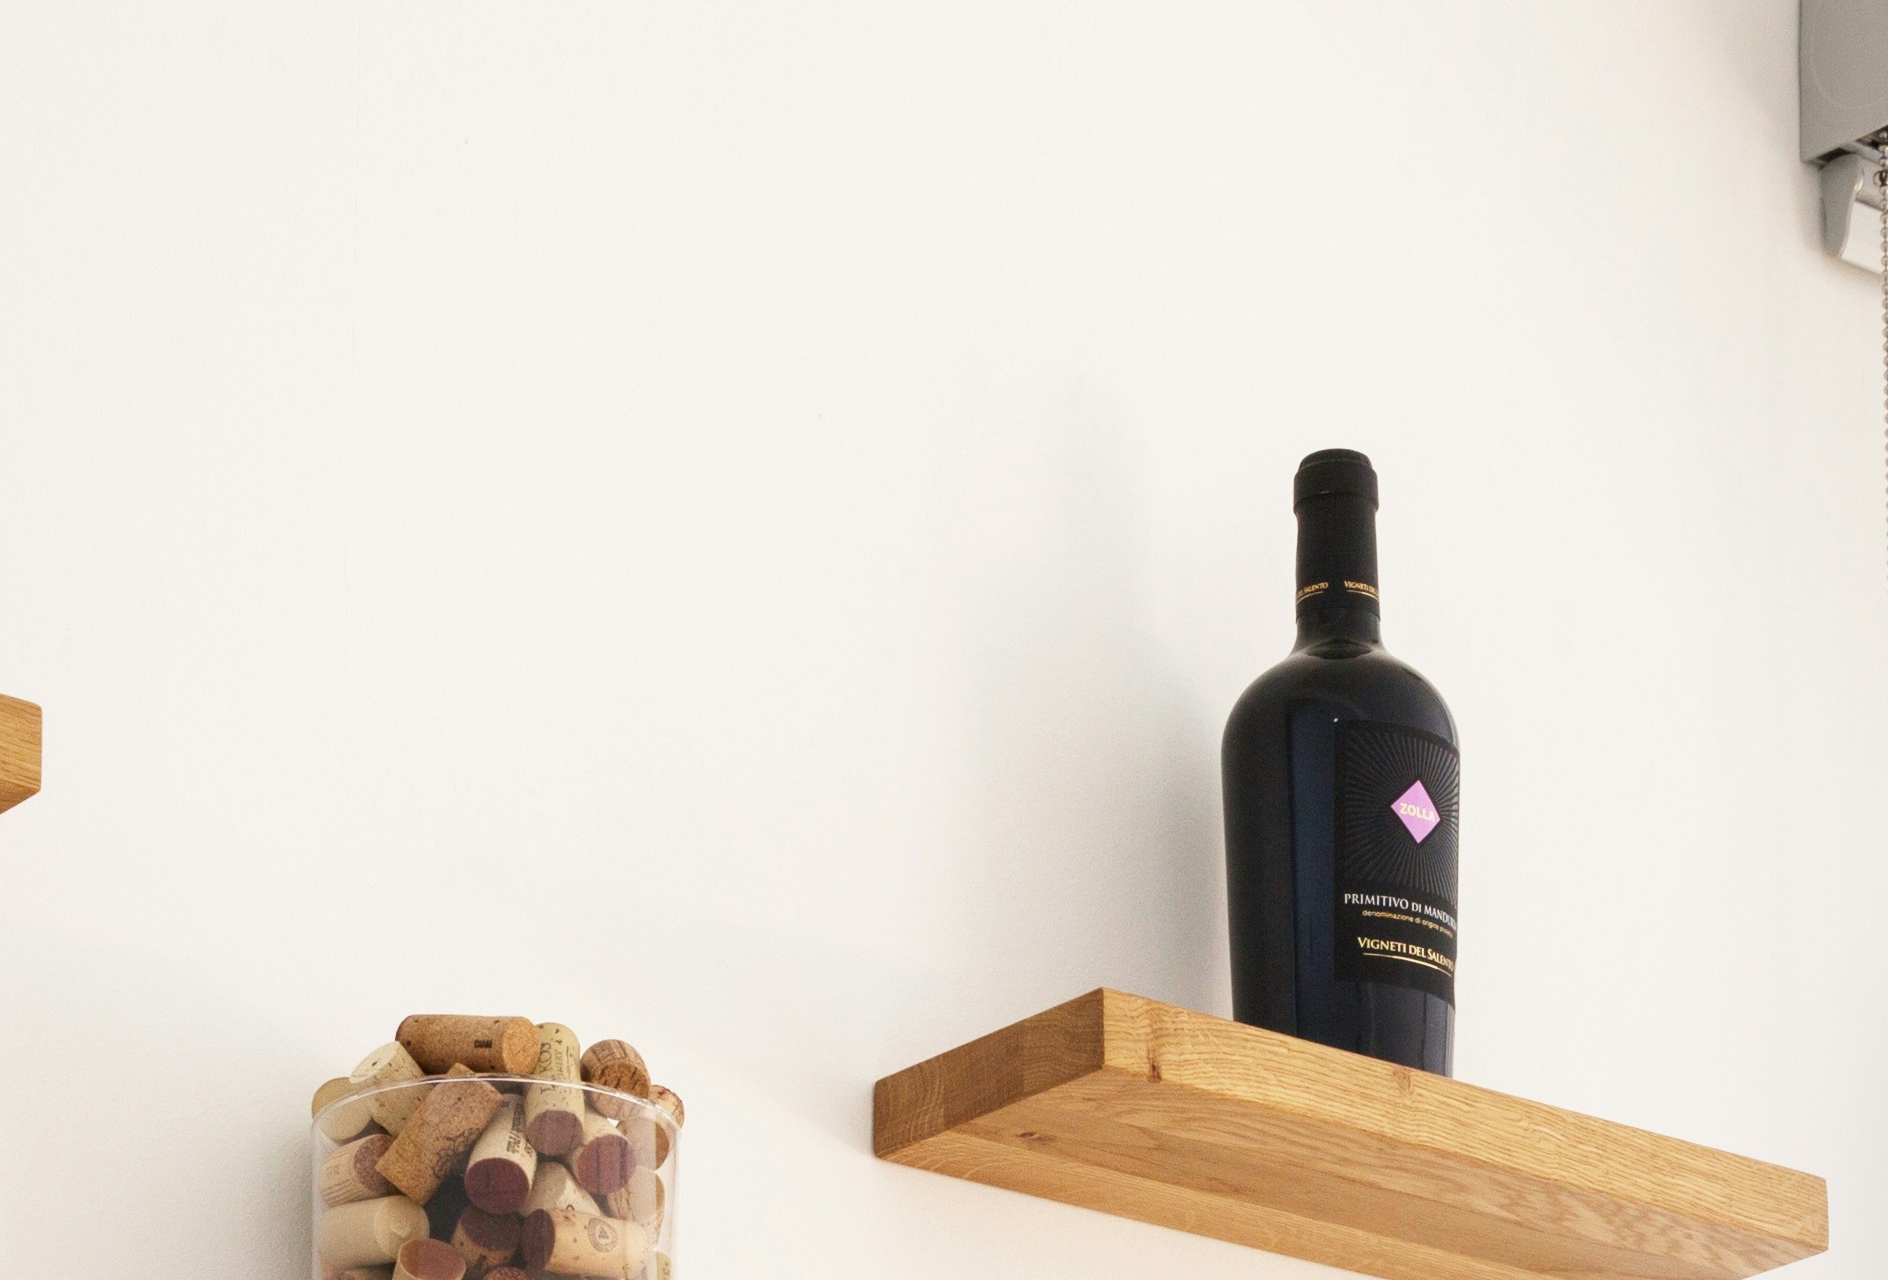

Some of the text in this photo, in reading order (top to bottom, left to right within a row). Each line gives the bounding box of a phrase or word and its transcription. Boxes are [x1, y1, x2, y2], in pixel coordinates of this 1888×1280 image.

[1399, 802, 1435, 822] ZOLLA
[1344, 893, 1409, 910] PRIMITIVO
[1411, 902, 1422, 913] DI
[1357, 936, 1407, 953] VIGNETI
[1408, 944, 1426, 959] DEL
